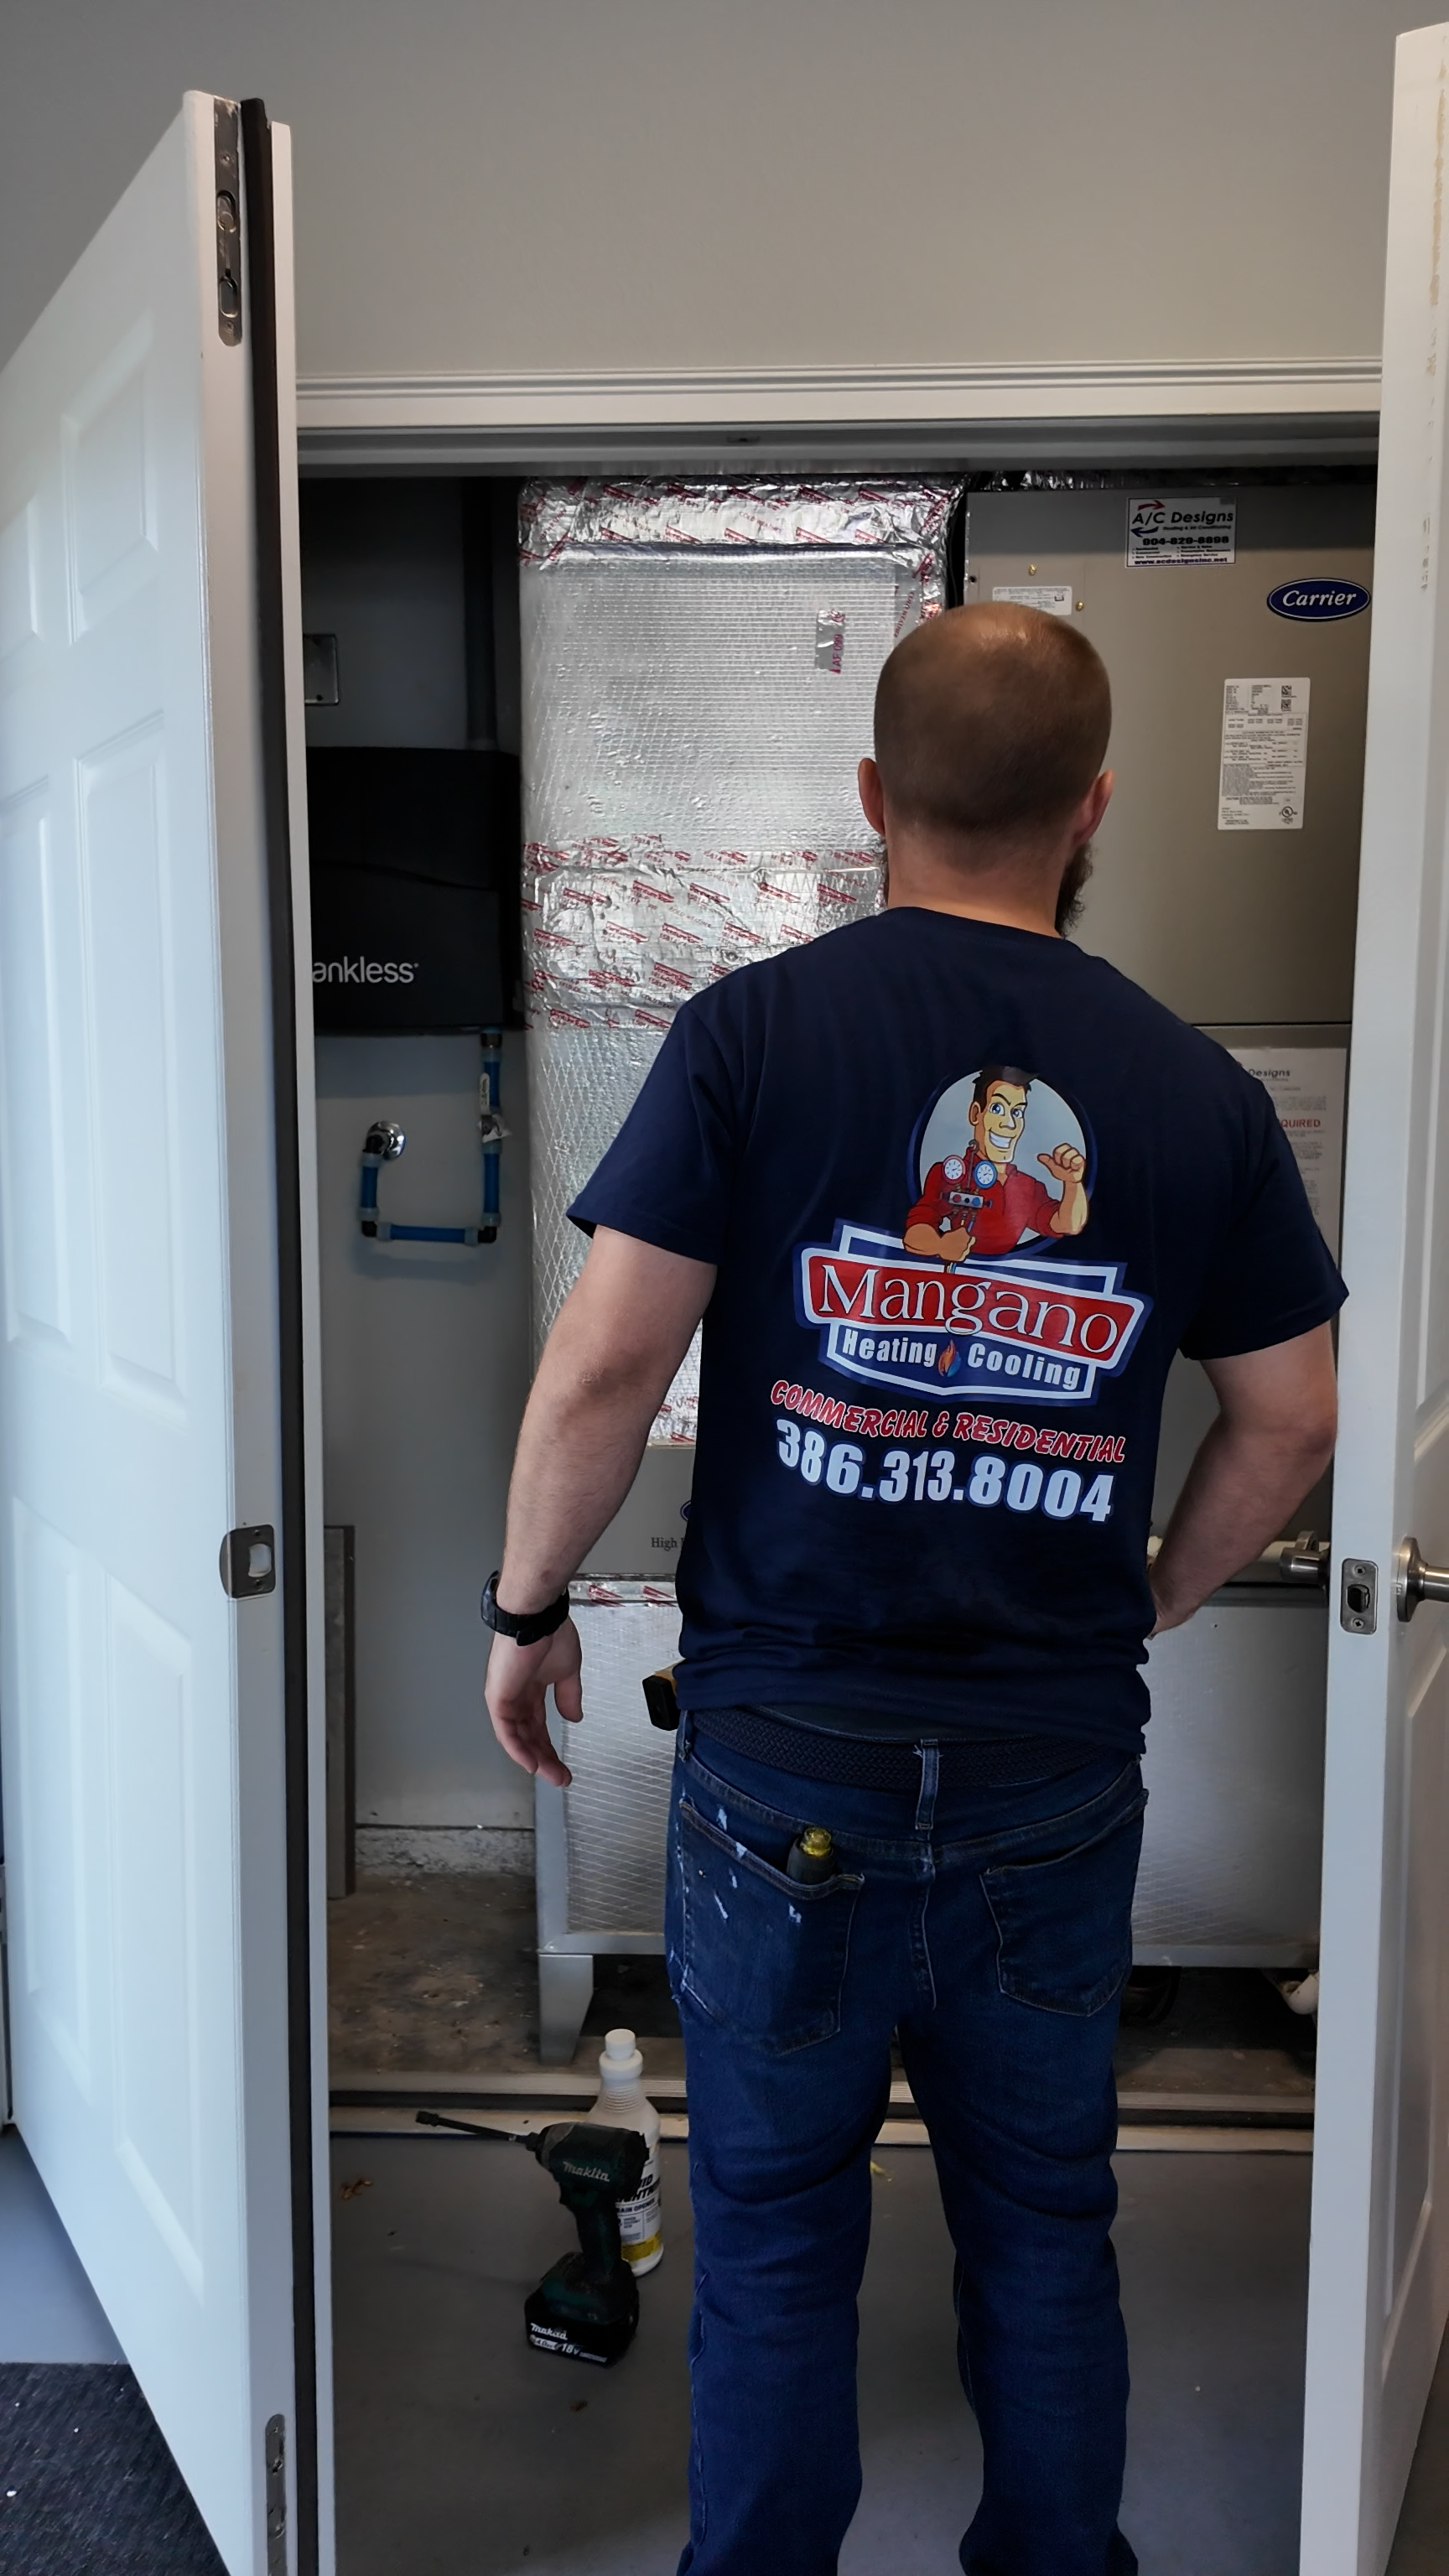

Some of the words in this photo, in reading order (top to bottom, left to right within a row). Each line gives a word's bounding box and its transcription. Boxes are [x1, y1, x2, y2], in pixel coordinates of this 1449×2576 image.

[1132, 512, 1166, 526] A/C
[1171, 510, 1233, 525] Designs
[1282, 589, 1357, 607] Carrier
[313, 955, 415, 983] ankless
[1249, 1068, 1291, 1078] Designs
[1280, 1119, 1321, 1128] QUIRED
[818, 1264, 1119, 1355] Mangano
[842, 1327, 938, 1368] Heating
[967, 1342, 1081, 1391] Cooling
[770, 1379, 928, 1439] COMMERCIAL
[932, 1410, 950, 1438] &
[953, 1411, 1126, 1463] RESIDENTIAL
[775, 1418, 1116, 1523] 386.313.8004
[651, 1537, 678, 1551] High
